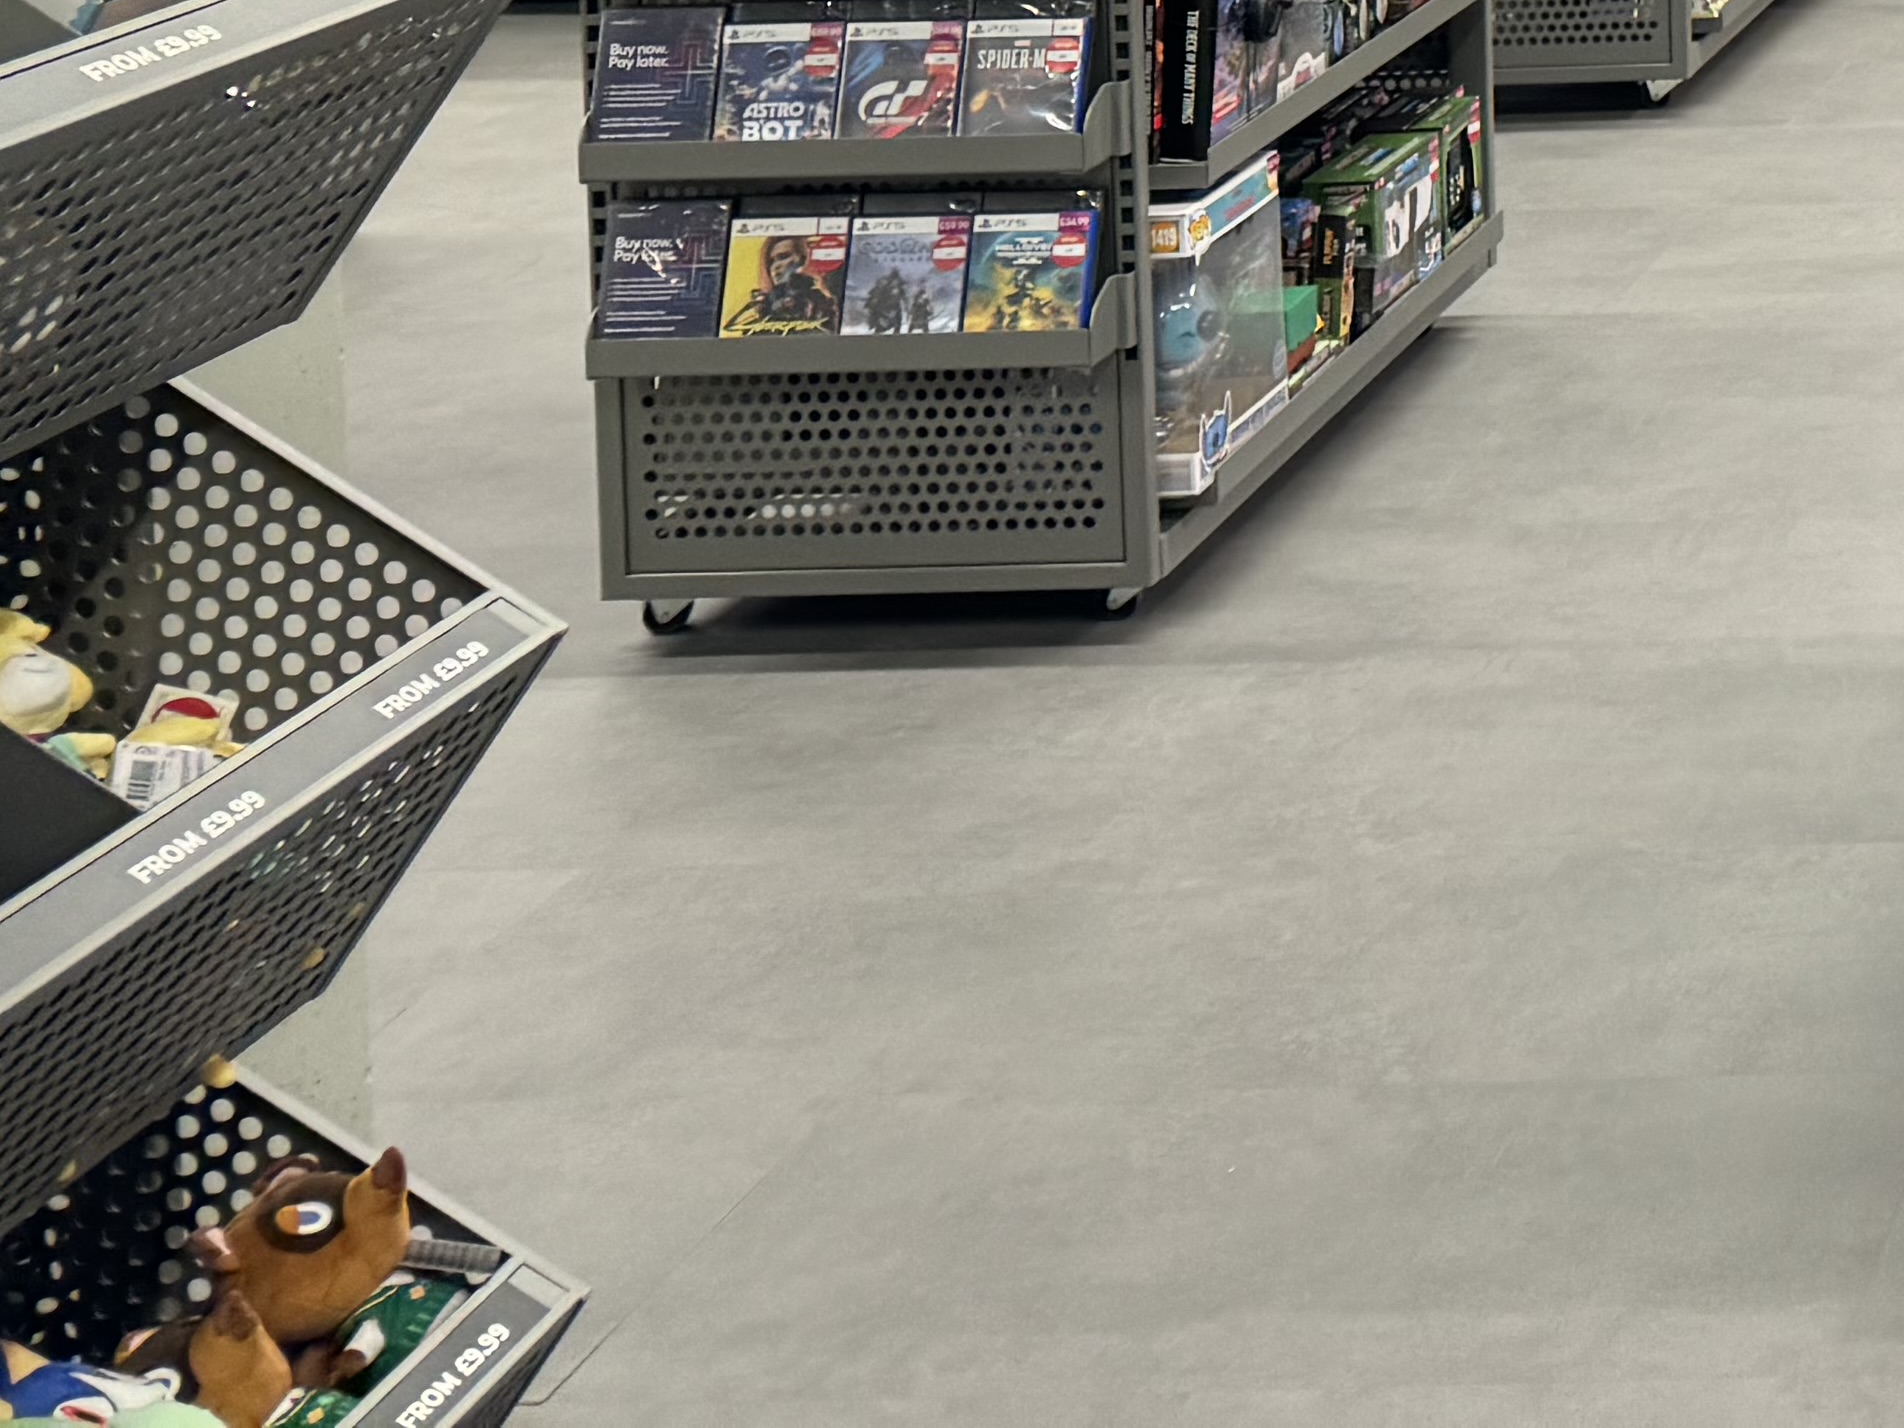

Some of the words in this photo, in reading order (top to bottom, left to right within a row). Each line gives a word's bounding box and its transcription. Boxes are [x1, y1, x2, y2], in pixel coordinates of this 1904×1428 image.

[79, 40, 153, 85] FROM
[154, 25, 223, 65] £9.99
[371, 671, 440, 723] FROM
[430, 639, 491, 684] £9.99
